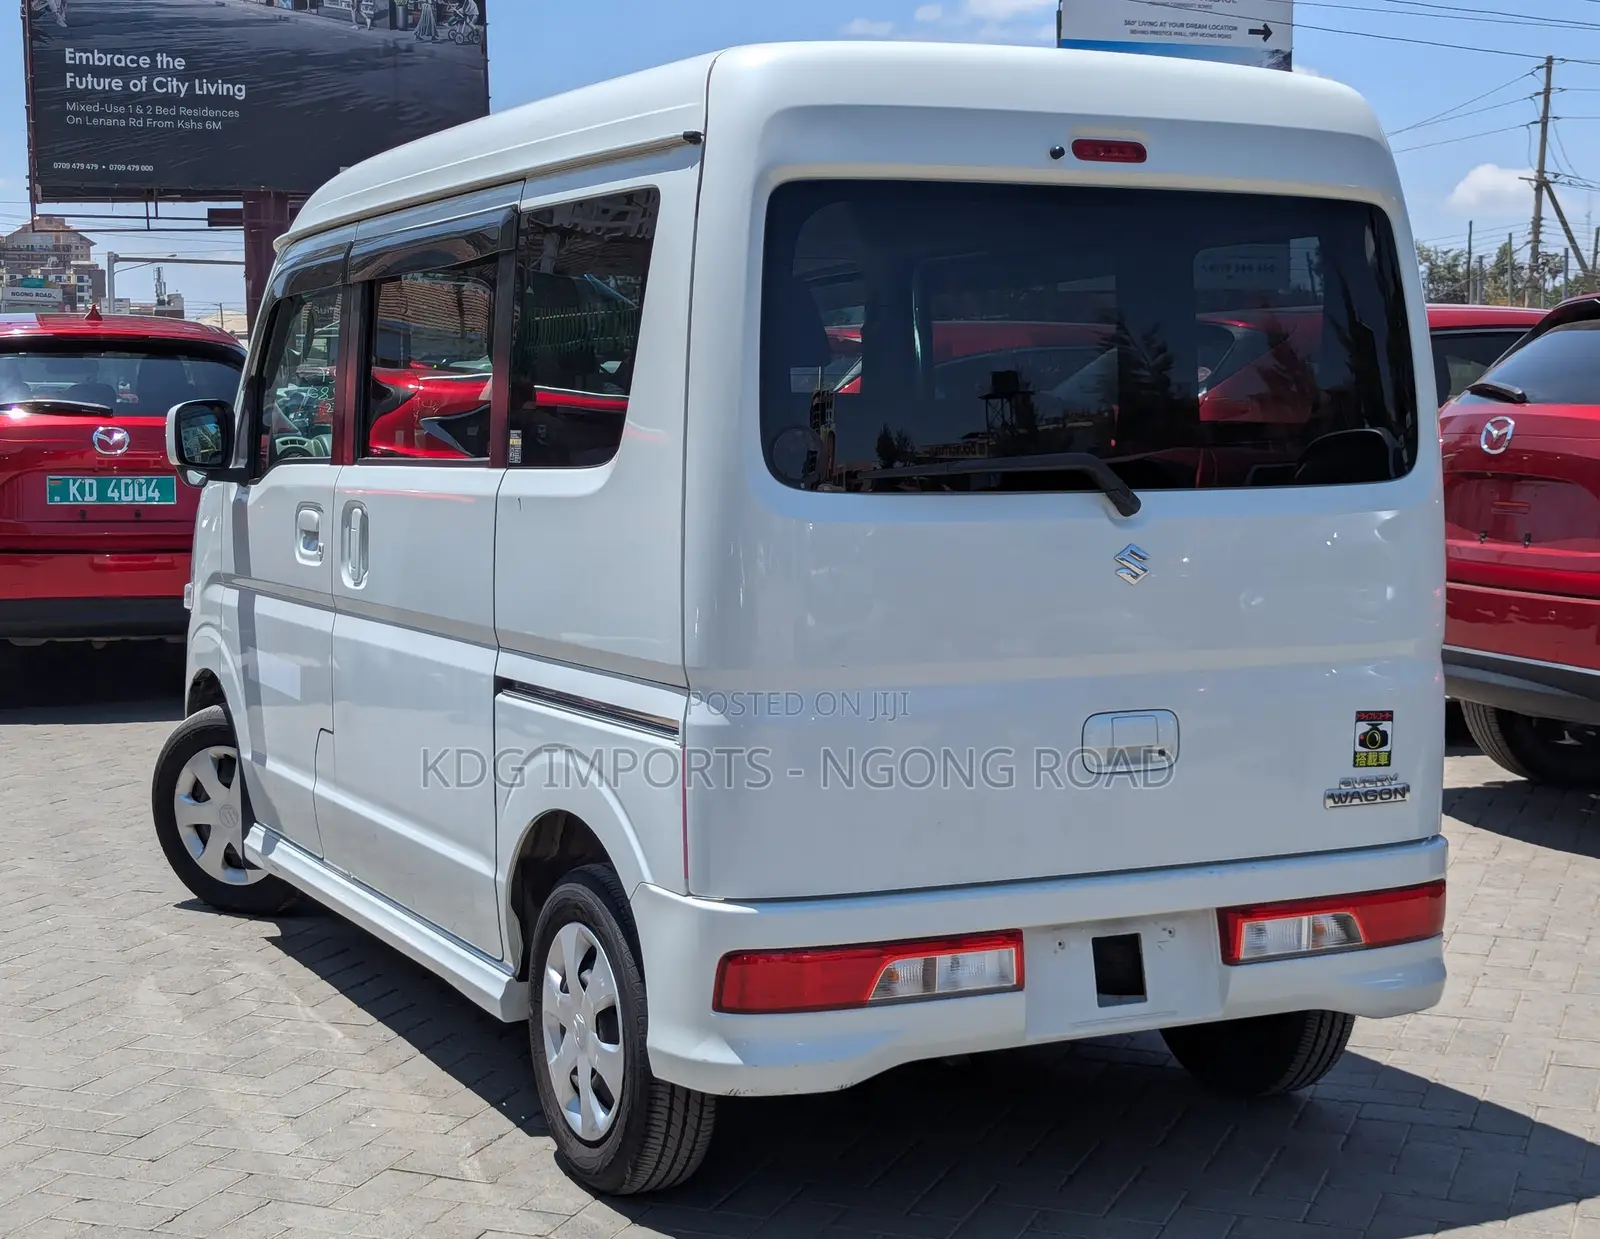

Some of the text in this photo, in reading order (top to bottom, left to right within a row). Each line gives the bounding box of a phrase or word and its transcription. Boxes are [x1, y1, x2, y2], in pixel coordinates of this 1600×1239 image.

[1138, 20, 1158, 28] LIVING
[1168, 21, 1185, 29] YOUR
[1185, 22, 1208, 30] DREAM
[1208, 23, 1238, 31] LOCATION
[65, 48, 186, 70] Embrace the
[66, 72, 246, 100] Future of City Living
[66, 102, 240, 118] Mixed-Use 1 & 2 Bed Residences
[66, 115, 222, 130] On Lenana Rd From Kshs 6M
[53, 162, 71, 170] 0709
[109, 163, 126, 171] 0709
[140, 164, 154, 172] 000
[68, 478, 160, 502] KD 4004
[1355, 752, 1389, 767] 搭載車
[1326, 785, 1410, 805] WAGON
